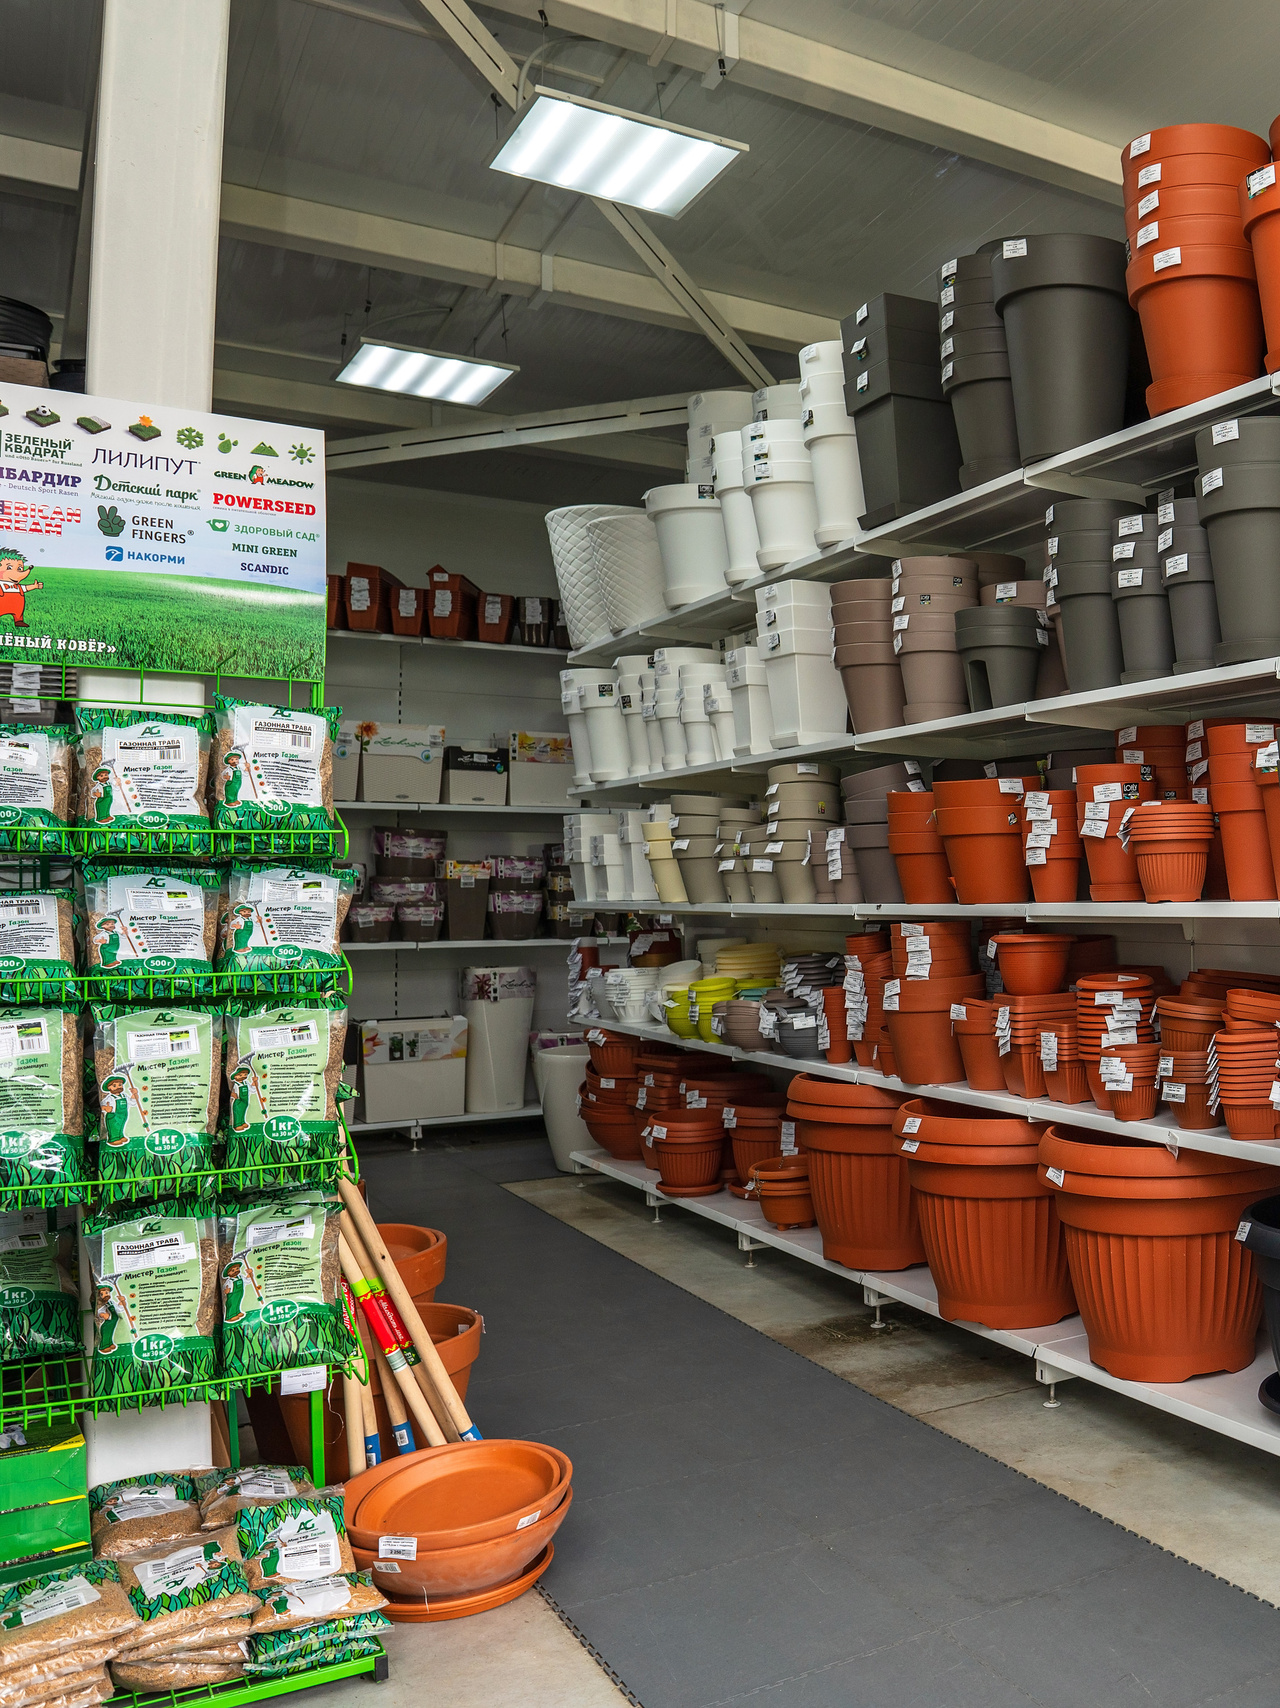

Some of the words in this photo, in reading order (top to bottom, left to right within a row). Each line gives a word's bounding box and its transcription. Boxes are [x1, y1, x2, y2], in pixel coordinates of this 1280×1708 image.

[5, 433, 72, 450] ЗЕЛЕНЫЙ
[5, 443, 66, 459] КВАДРАТ
[91, 448, 198, 475] ЛИЛИПУТ
[214, 470, 247, 481] GREEN
[266, 477, 314, 489] MEADOW
[8, 483, 37, 492] Deutsch
[38, 487, 57, 495] Sport
[59, 489, 79, 497] Rasen
[93, 474, 162, 497] Детский
[165, 488, 199, 503] парк
[212, 492, 316, 516] POWERSEED
[132, 515, 174, 529] GREEN
[132, 529, 186, 544] FINGERS
[234, 524, 293, 538] ЗДОРОВЫЙ
[295, 531, 317, 543] САД
[231, 542, 259, 554] MINI
[261, 545, 298, 558] GREEN
[127, 551, 185, 565] НАКОРМИ
[240, 562, 289, 576] SCANDIC
[141, 725, 161, 736] AG
[254, 720, 290, 730] ГАЗОННАЯ
[292, 724, 312, 732] ТРАВА
[253, 751, 279, 759] Мистер
[123, 765, 151, 773] Мистер
[286, 870, 306, 879] AG
[146, 877, 166, 887] AG
[8, 918, 30, 926] Газон
[129, 914, 157, 922] Мистер
[154, 1012, 175, 1023] AG
[275, 1011, 294, 1022] AG
[257, 1050, 285, 1060] Мистер
[287, 1047, 307, 1055] Газон
[16, 1057, 38, 1065] Газон
[137, 1062, 166, 1072] Мистер
[169, 1058, 190, 1066] Газон
[273, 1207, 292, 1215] AG
[116, 1242, 155, 1251] ГАЗОННАЯ
[156, 1237, 180, 1246] ТРАВА
[253, 1244, 280, 1254] Мистер
[124, 1270, 154, 1280] Мистер
[296, 1518, 315, 1533] AG
